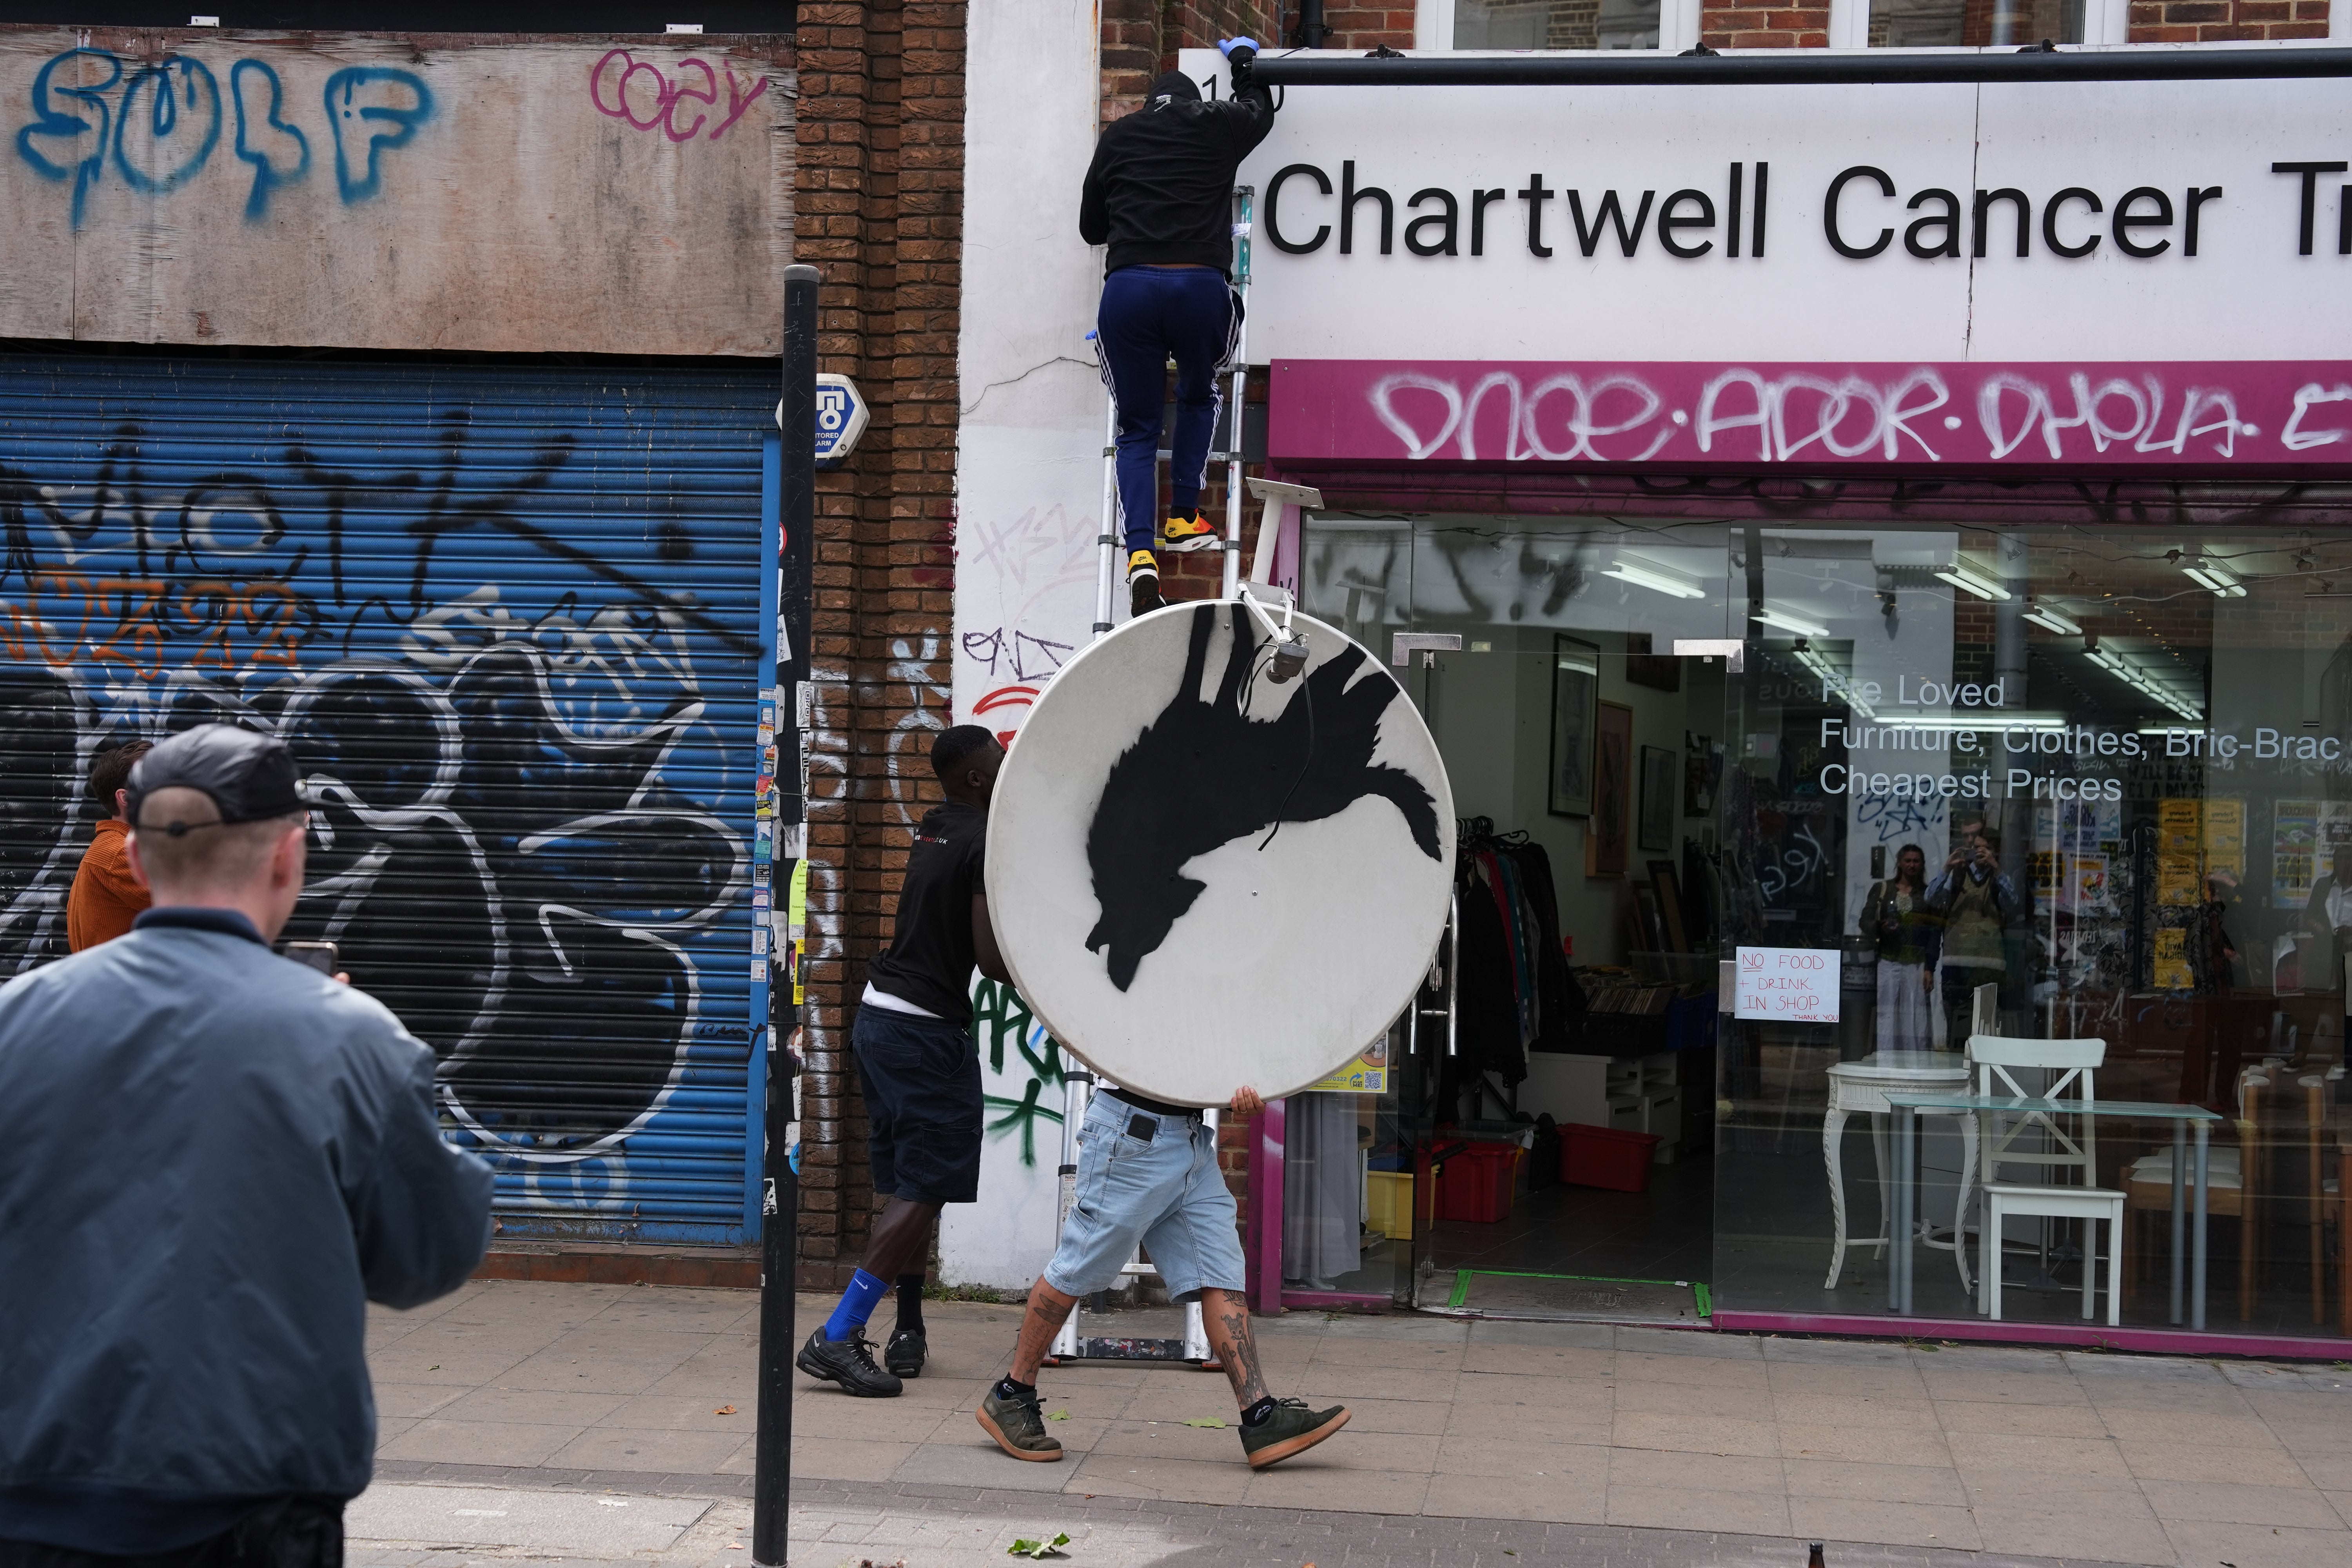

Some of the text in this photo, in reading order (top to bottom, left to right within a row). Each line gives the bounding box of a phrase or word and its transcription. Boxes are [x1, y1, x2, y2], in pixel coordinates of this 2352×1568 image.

[1265, 160, 1768, 258] Chartwell
[1824, 165, 2222, 259] Cancer
[1822, 673, 1882, 704] Pre
[1899, 674, 2004, 707] Loved
[1821, 719, 1984, 757] Furniture,
[2003, 724, 2148, 761] Clothes,
[2166, 727, 2341, 760] Bric-Brac
[1820, 763, 2122, 804] Cheapest Prices
[1742, 953, 1824, 969] NO FOOD
[1759, 977, 1813, 990] DRINK
[1743, 995, 1819, 1011] IN SHOP
